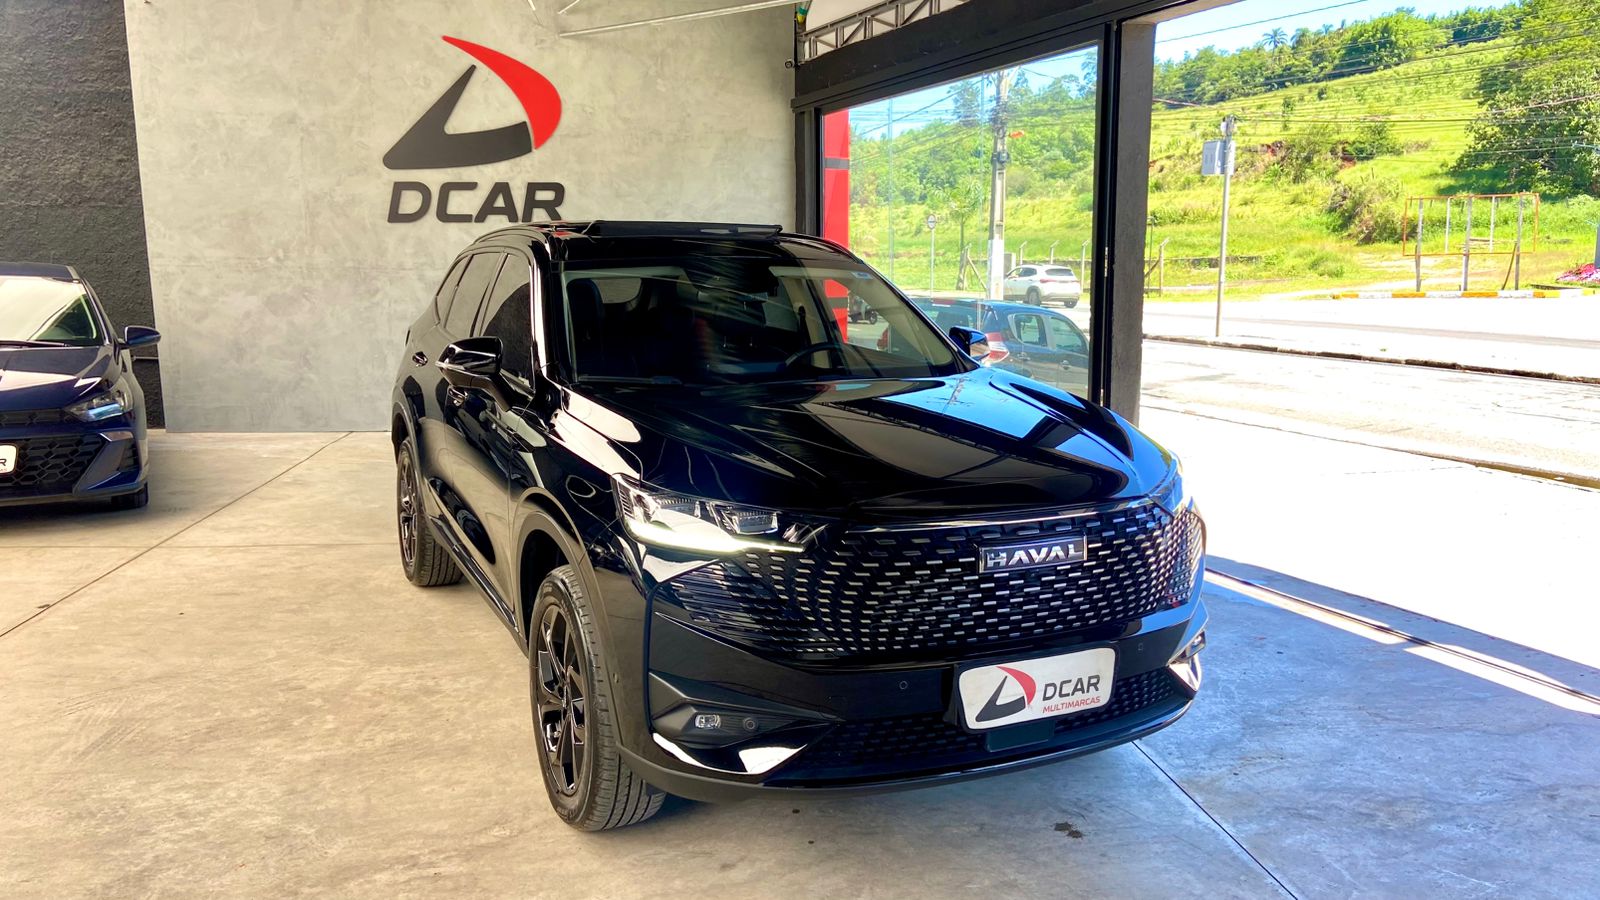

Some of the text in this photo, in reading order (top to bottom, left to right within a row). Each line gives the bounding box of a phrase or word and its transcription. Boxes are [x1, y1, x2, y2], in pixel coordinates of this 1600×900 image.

[387, 181, 565, 223] DCAR
[986, 544, 1083, 567] HAVAL
[1042, 675, 1100, 701] DCAR
[1042, 696, 1101, 713] MULTIMARCAS
